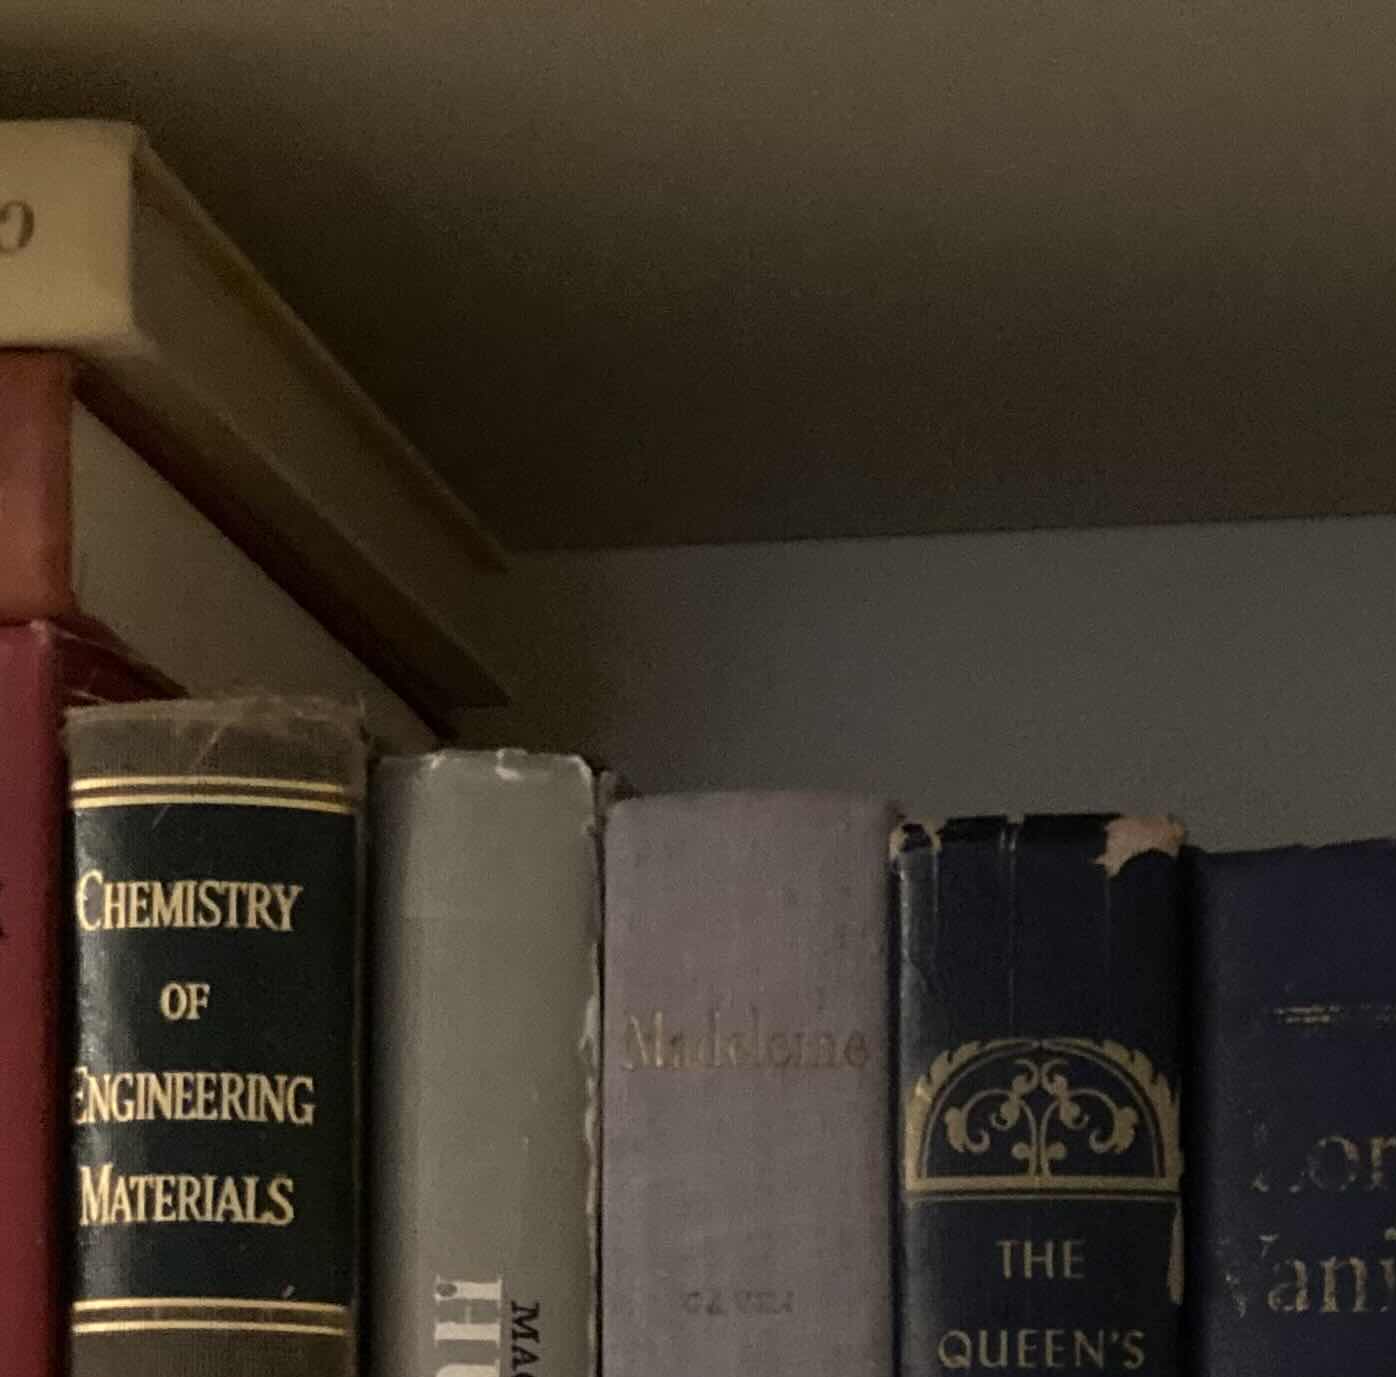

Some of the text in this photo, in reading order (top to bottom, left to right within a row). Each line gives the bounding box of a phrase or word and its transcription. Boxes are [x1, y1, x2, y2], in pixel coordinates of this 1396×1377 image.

[160, 980, 211, 1021] OF
[995, 1238, 1086, 1281] THE
[936, 1327, 1147, 1372] QUEEN'S
